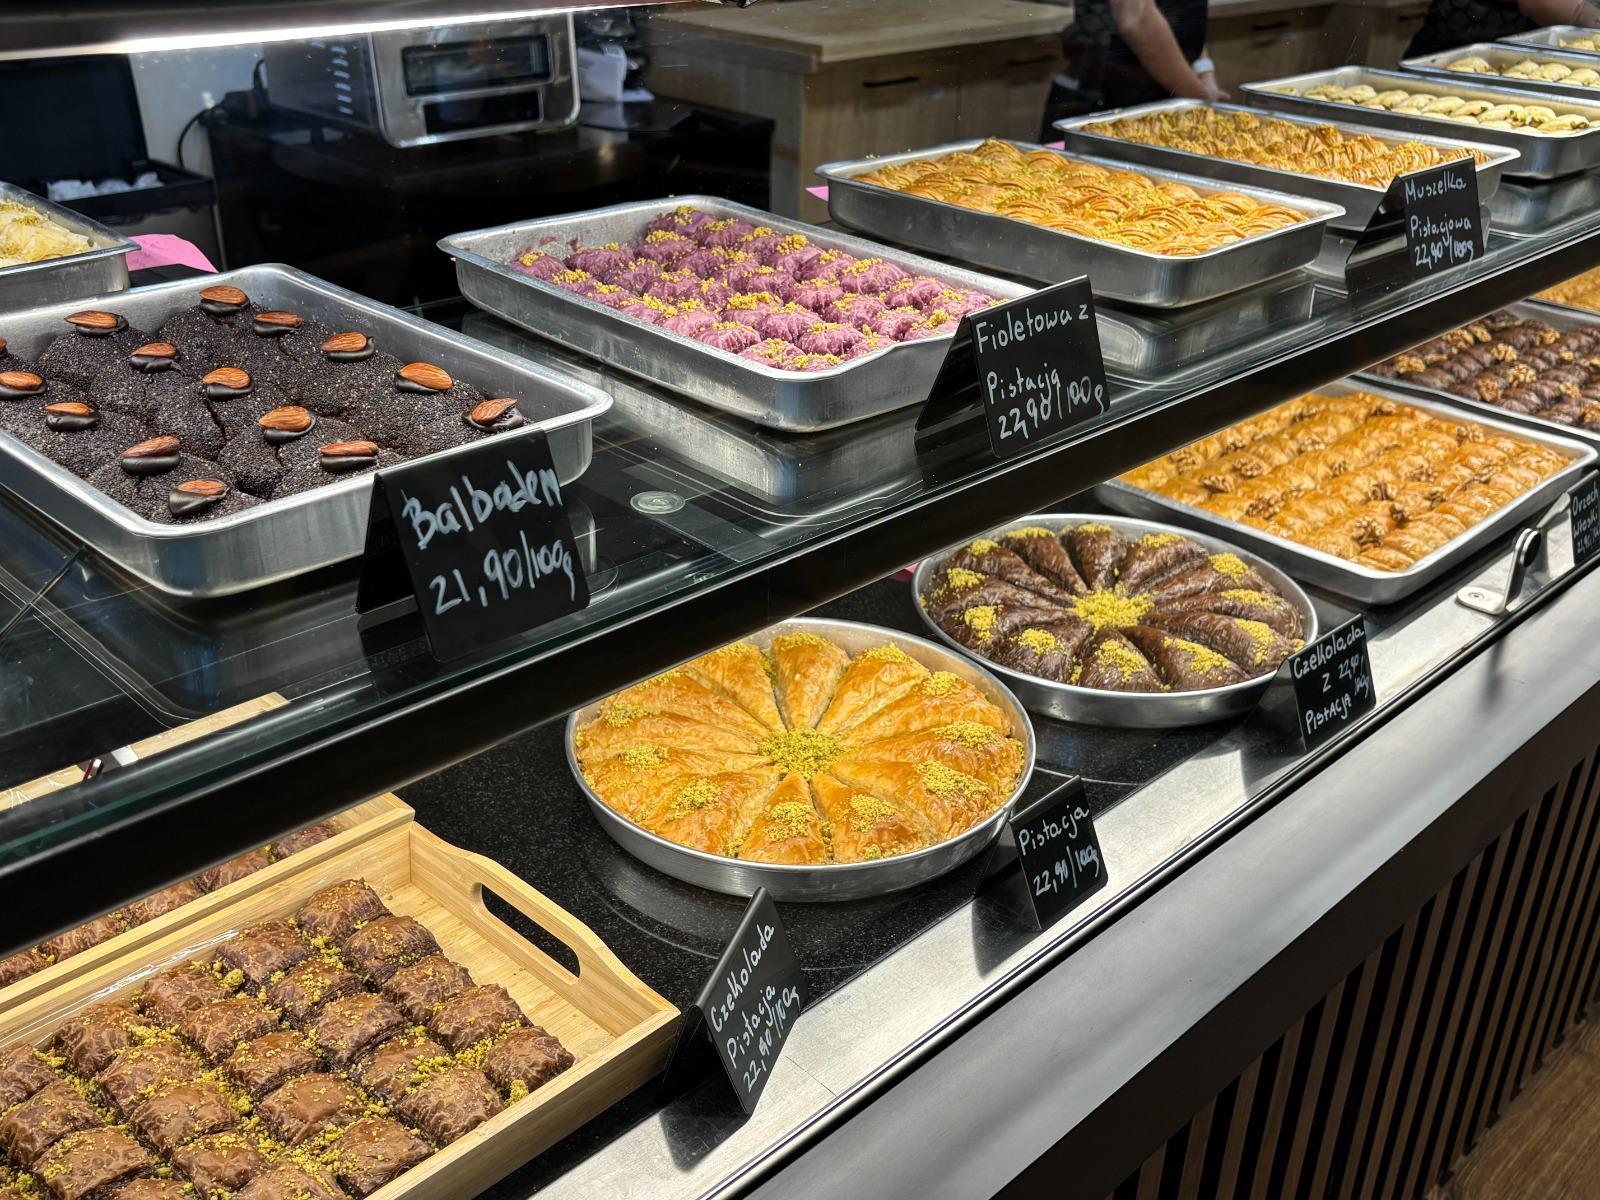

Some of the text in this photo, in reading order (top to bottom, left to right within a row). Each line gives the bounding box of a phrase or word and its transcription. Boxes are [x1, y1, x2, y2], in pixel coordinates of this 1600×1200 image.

[1410, 213, 1472, 247] Pistacjowa
[975, 307, 1073, 354] Fioletowa
[1572, 481, 1599, 517] Orzech
[429, 530, 576, 616] 21,90/100g
[1018, 804, 1090, 856] Pistacja
[726, 984, 776, 1069] Pistacja
